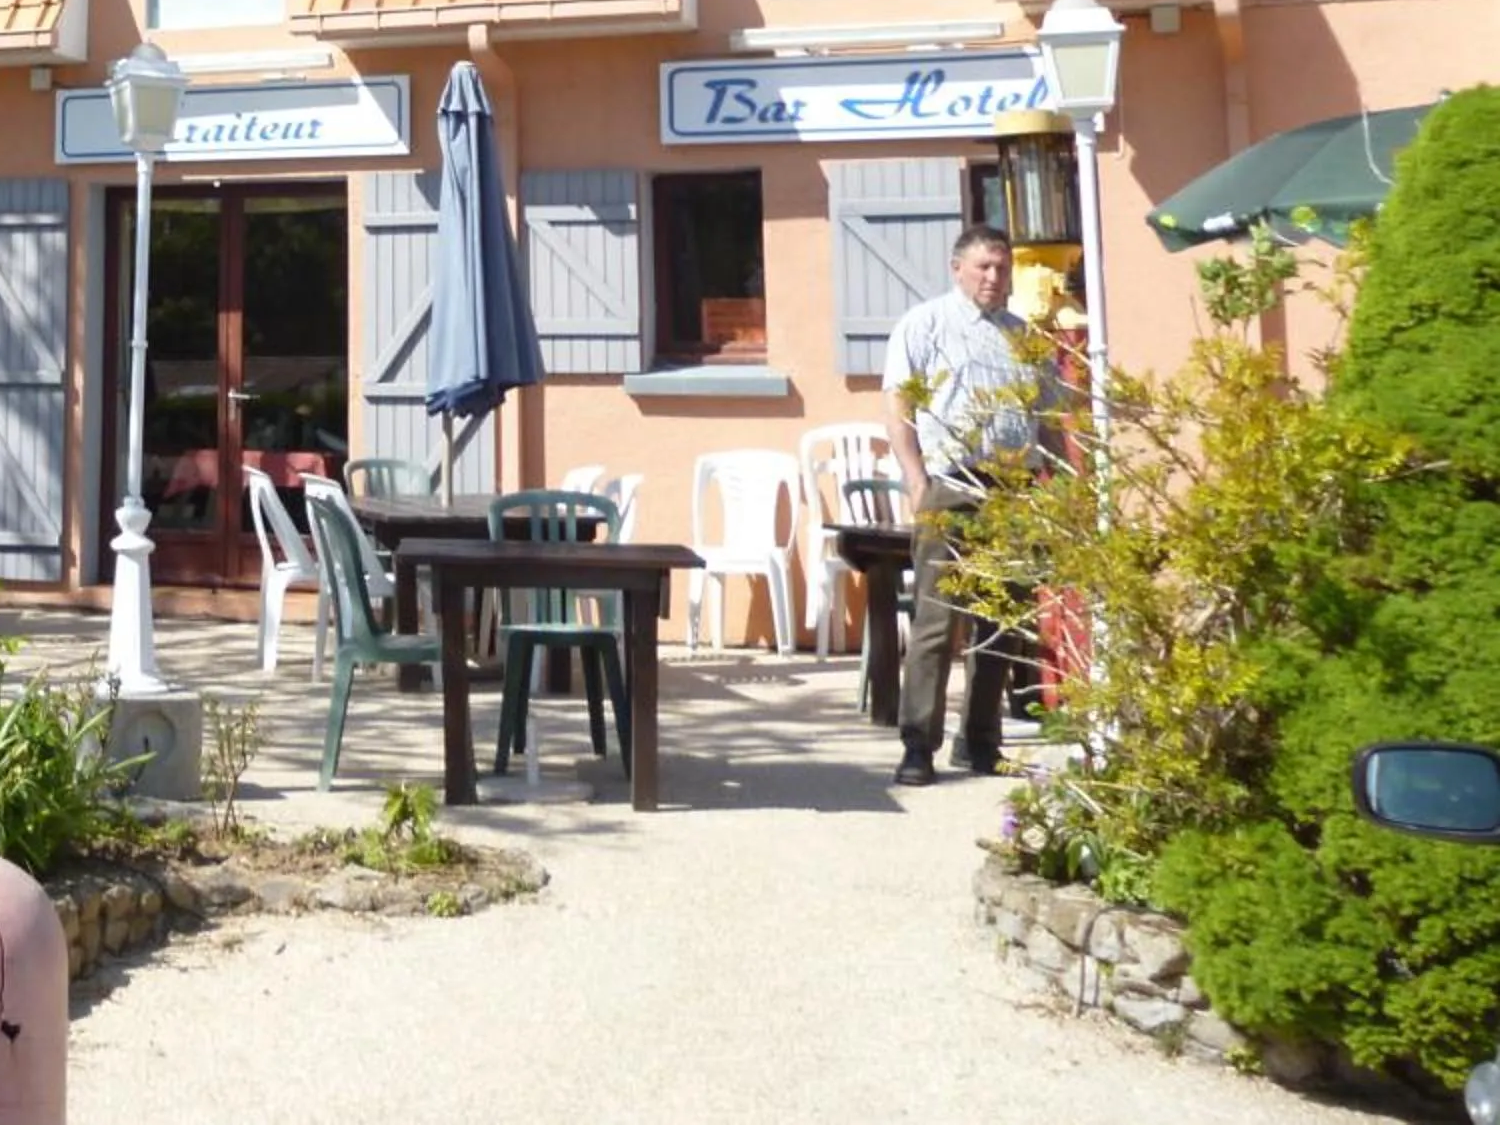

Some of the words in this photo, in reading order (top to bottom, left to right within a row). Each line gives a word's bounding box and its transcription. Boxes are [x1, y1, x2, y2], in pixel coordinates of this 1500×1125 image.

[703, 78, 807, 124] Bar
[839, 69, 1049, 120] Hotel
[180, 105, 323, 143] raiteur
